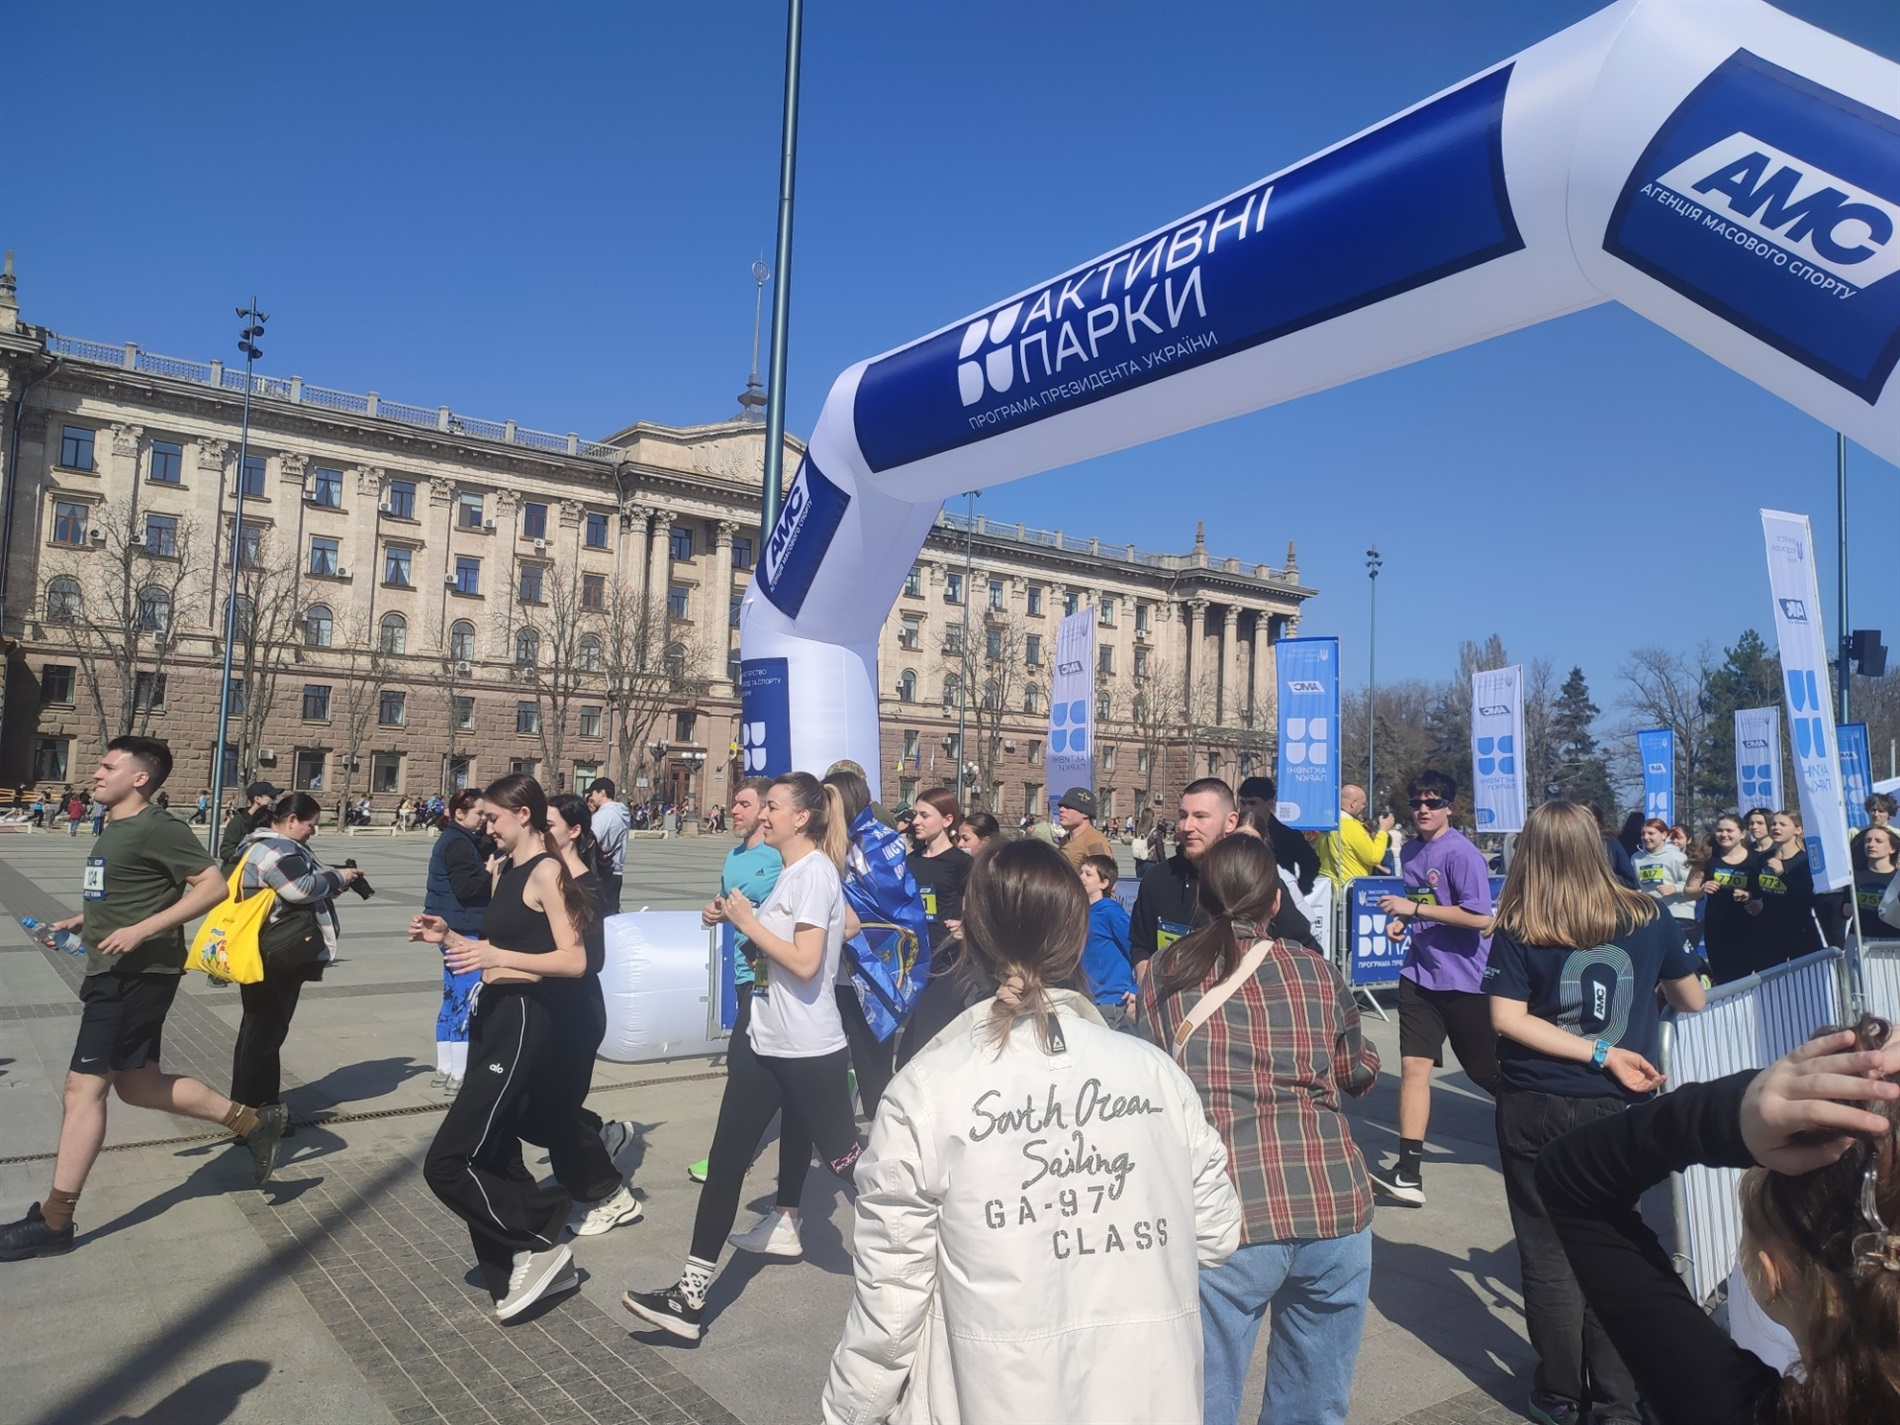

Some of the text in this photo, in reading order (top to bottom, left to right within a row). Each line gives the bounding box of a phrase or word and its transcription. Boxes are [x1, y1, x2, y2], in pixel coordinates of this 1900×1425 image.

[1021, 186, 1274, 333] АКТИВНІ
[1640, 182, 1857, 301] АГЕНЦІЯ МАСОВОГО СПОРТУ
[1019, 265, 1207, 384] ПАРКИ
[969, 330, 1218, 431] ПРОГРАМА ПРЕЗИДЕНТА УКРАЇНИ
[1763, 876, 1781, 888] 773
[969, 1077, 1164, 1143] South Ocean
[1022, 1130, 1135, 1201] Sailing
[1053, 1218, 1168, 1260] CLASS
